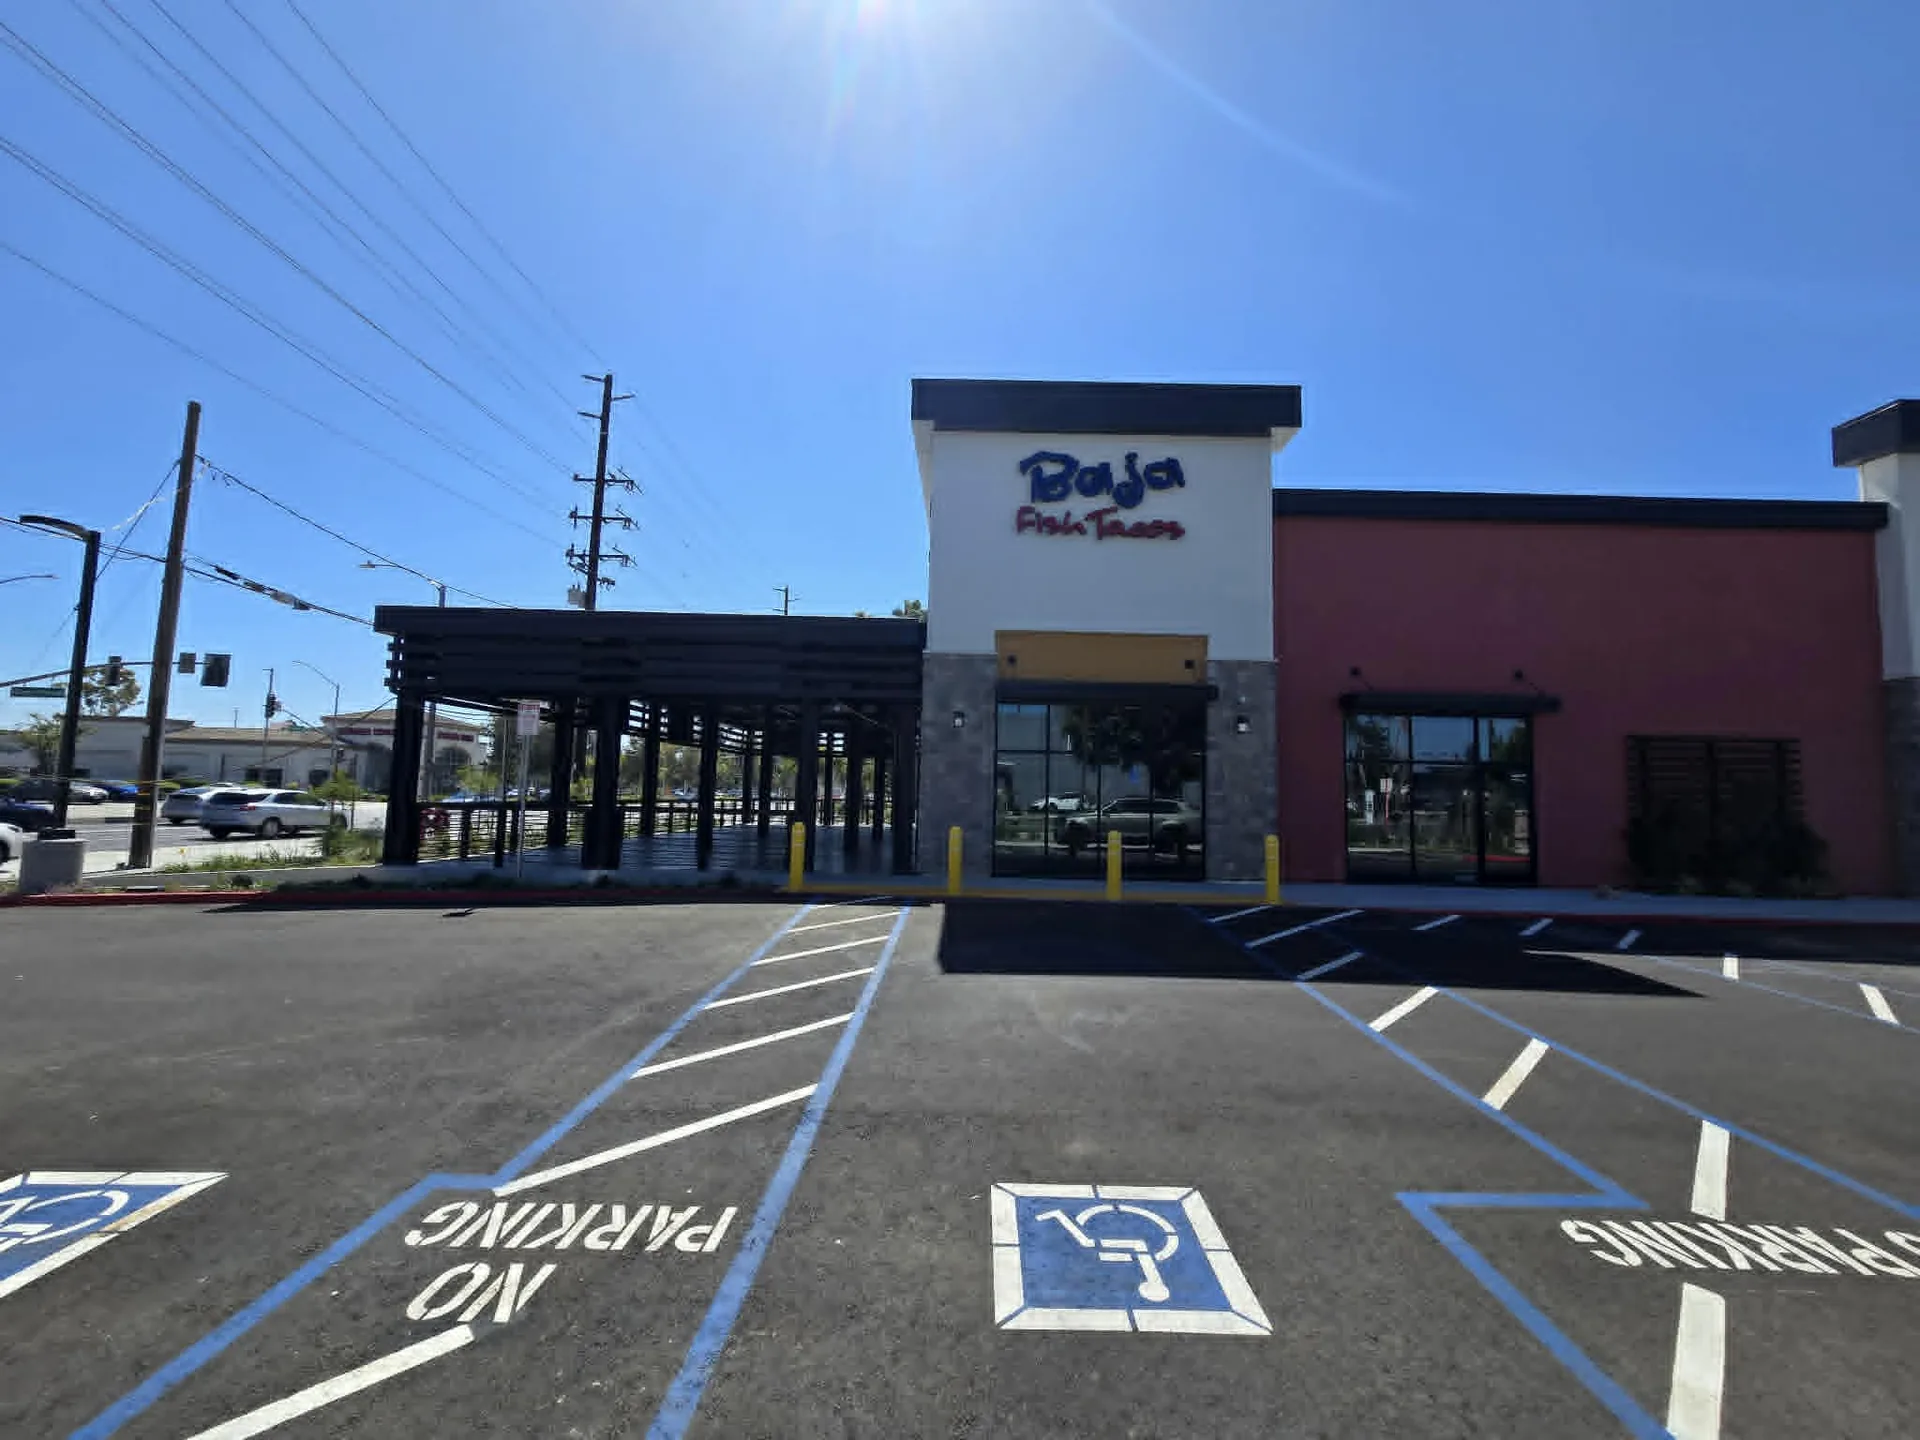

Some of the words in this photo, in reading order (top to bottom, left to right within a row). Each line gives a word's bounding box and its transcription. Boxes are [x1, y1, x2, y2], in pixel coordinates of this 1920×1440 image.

[1019, 450, 1185, 509] Baja
[1016, 505, 1087, 535] Fish
[1084, 506, 1186, 540] Tacos
[404, 1201, 738, 1253] PARKING
[1560, 1220, 1920, 1277] PARKING
[405, 1262, 558, 1324] NO
